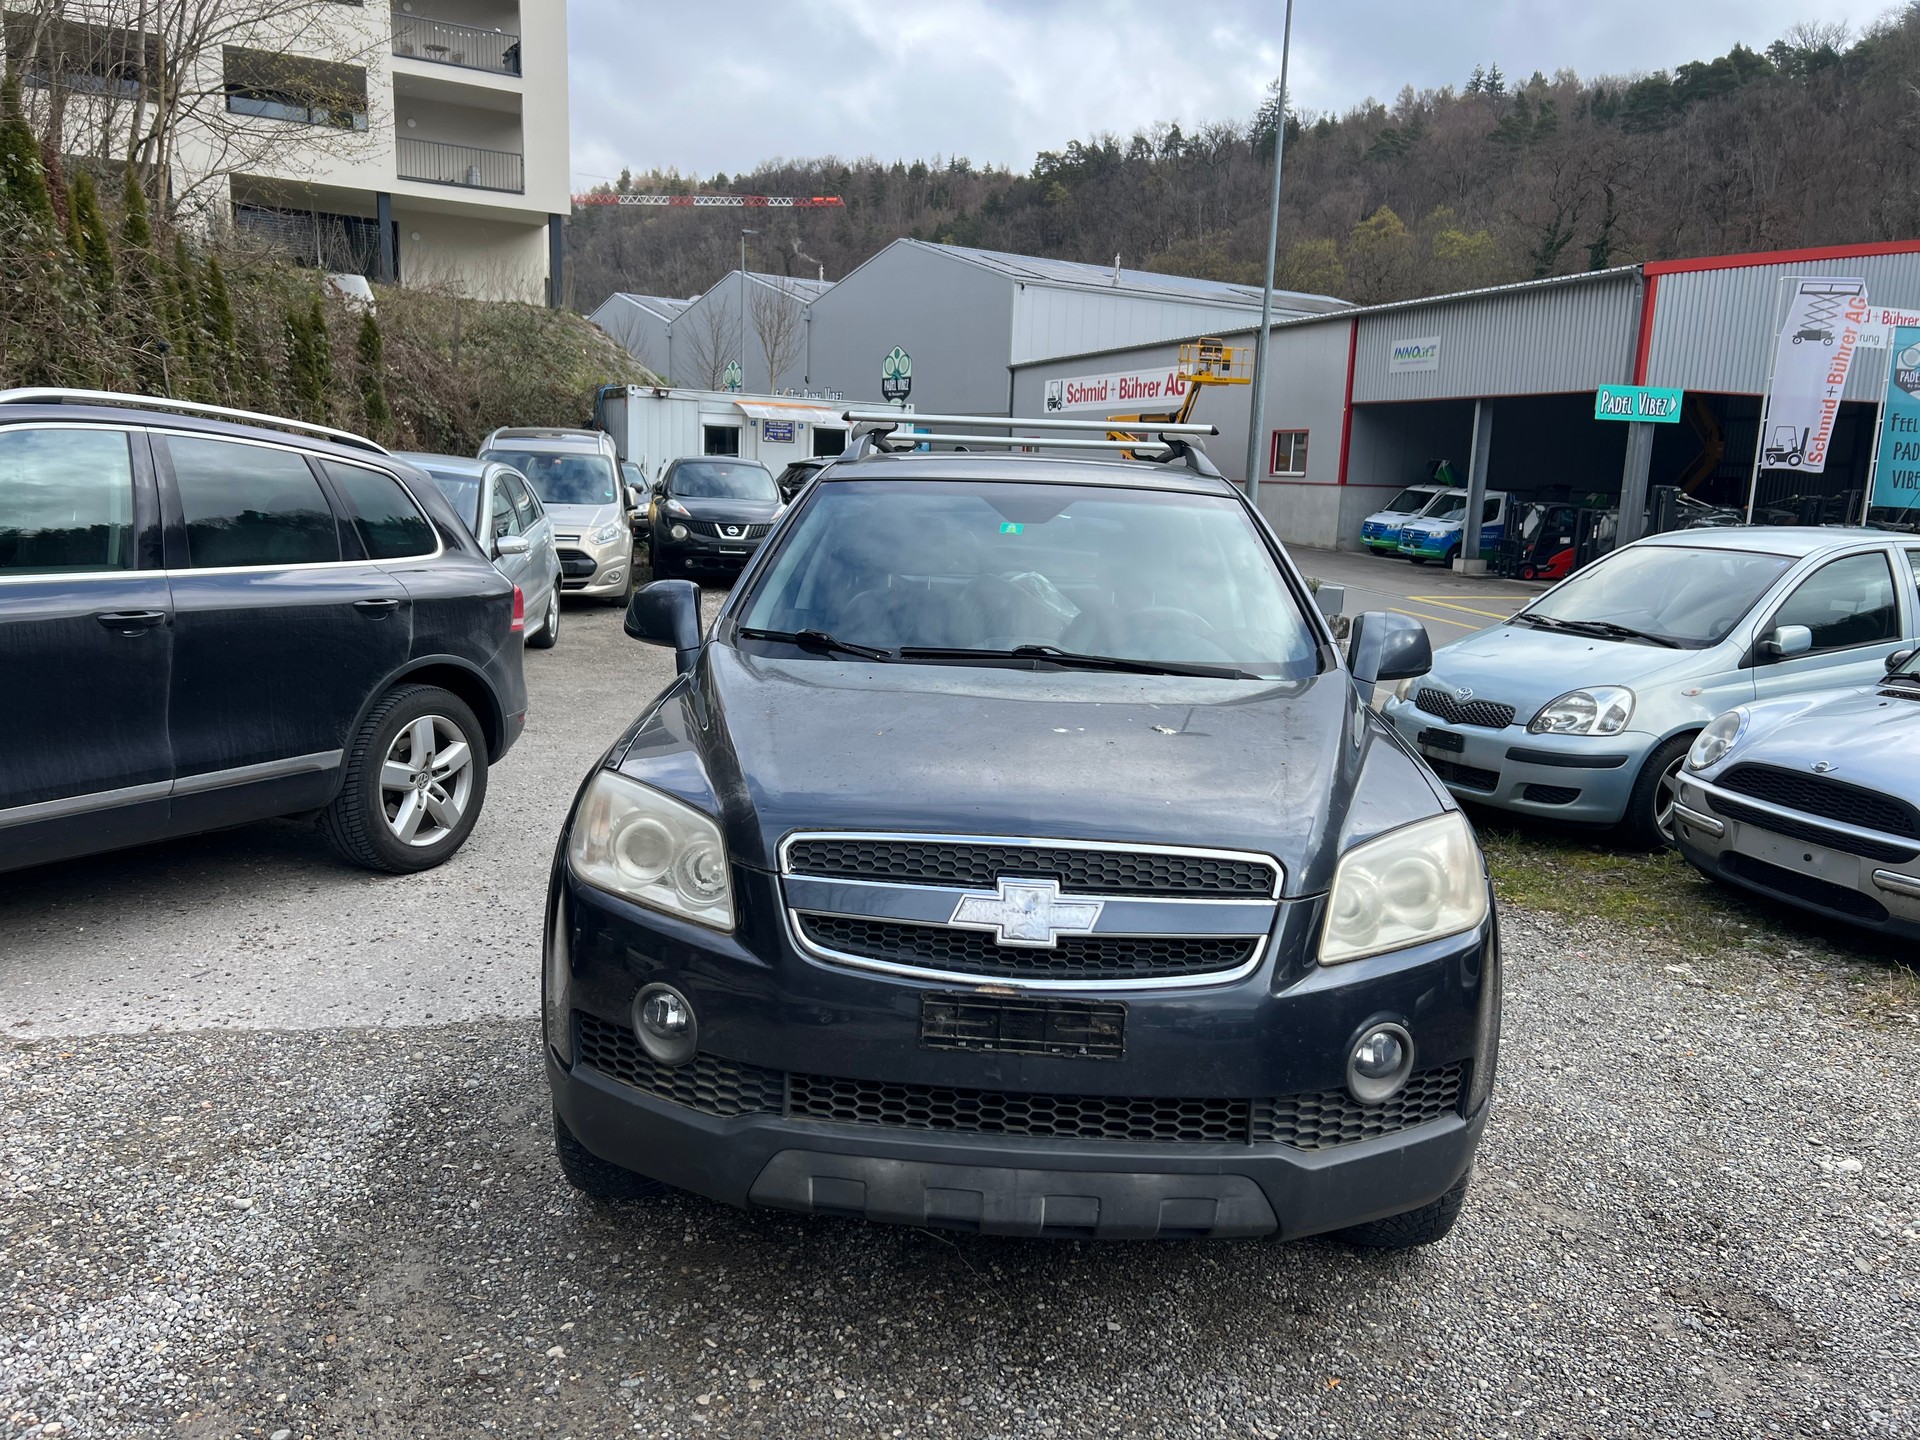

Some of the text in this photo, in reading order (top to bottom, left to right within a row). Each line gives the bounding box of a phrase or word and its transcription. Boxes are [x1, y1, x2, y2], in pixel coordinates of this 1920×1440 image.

[1882, 310, 1920, 326] Bührer
[1067, 380, 1108, 403] Schmid
[1119, 377, 1161, 400] Bührer
[1164, 371, 1186, 397] AG
[1808, 399, 1837, 463] Schmid
[1826, 326, 1858, 384] Bührer
[1845, 297, 1867, 324] AG
[1600, 390, 1668, 416] PADEL VIBEZ
[1891, 413, 1919, 432] FEEL
